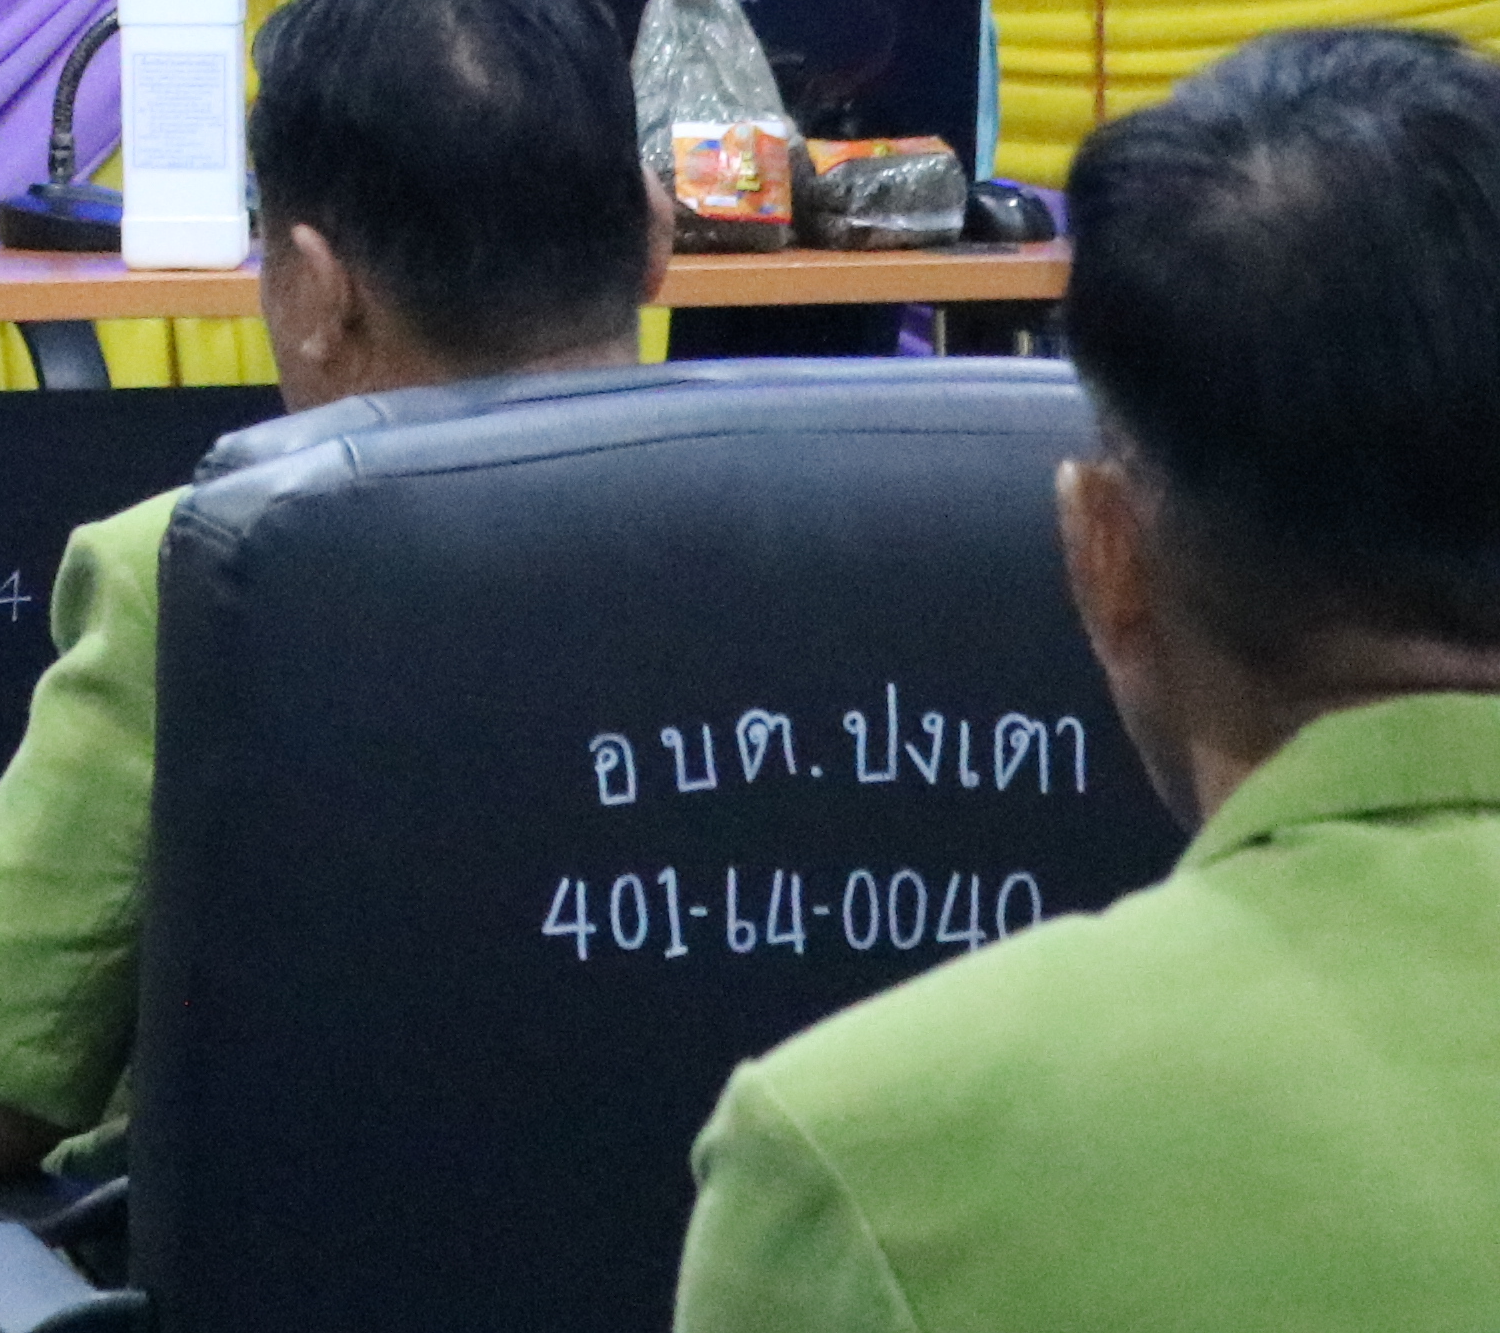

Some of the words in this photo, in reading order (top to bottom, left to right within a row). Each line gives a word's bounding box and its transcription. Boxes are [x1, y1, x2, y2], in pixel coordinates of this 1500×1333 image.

[590, 683, 1086, 806] อบต.ปงเตา
[542, 866, 1042, 961] 401-64-0040
